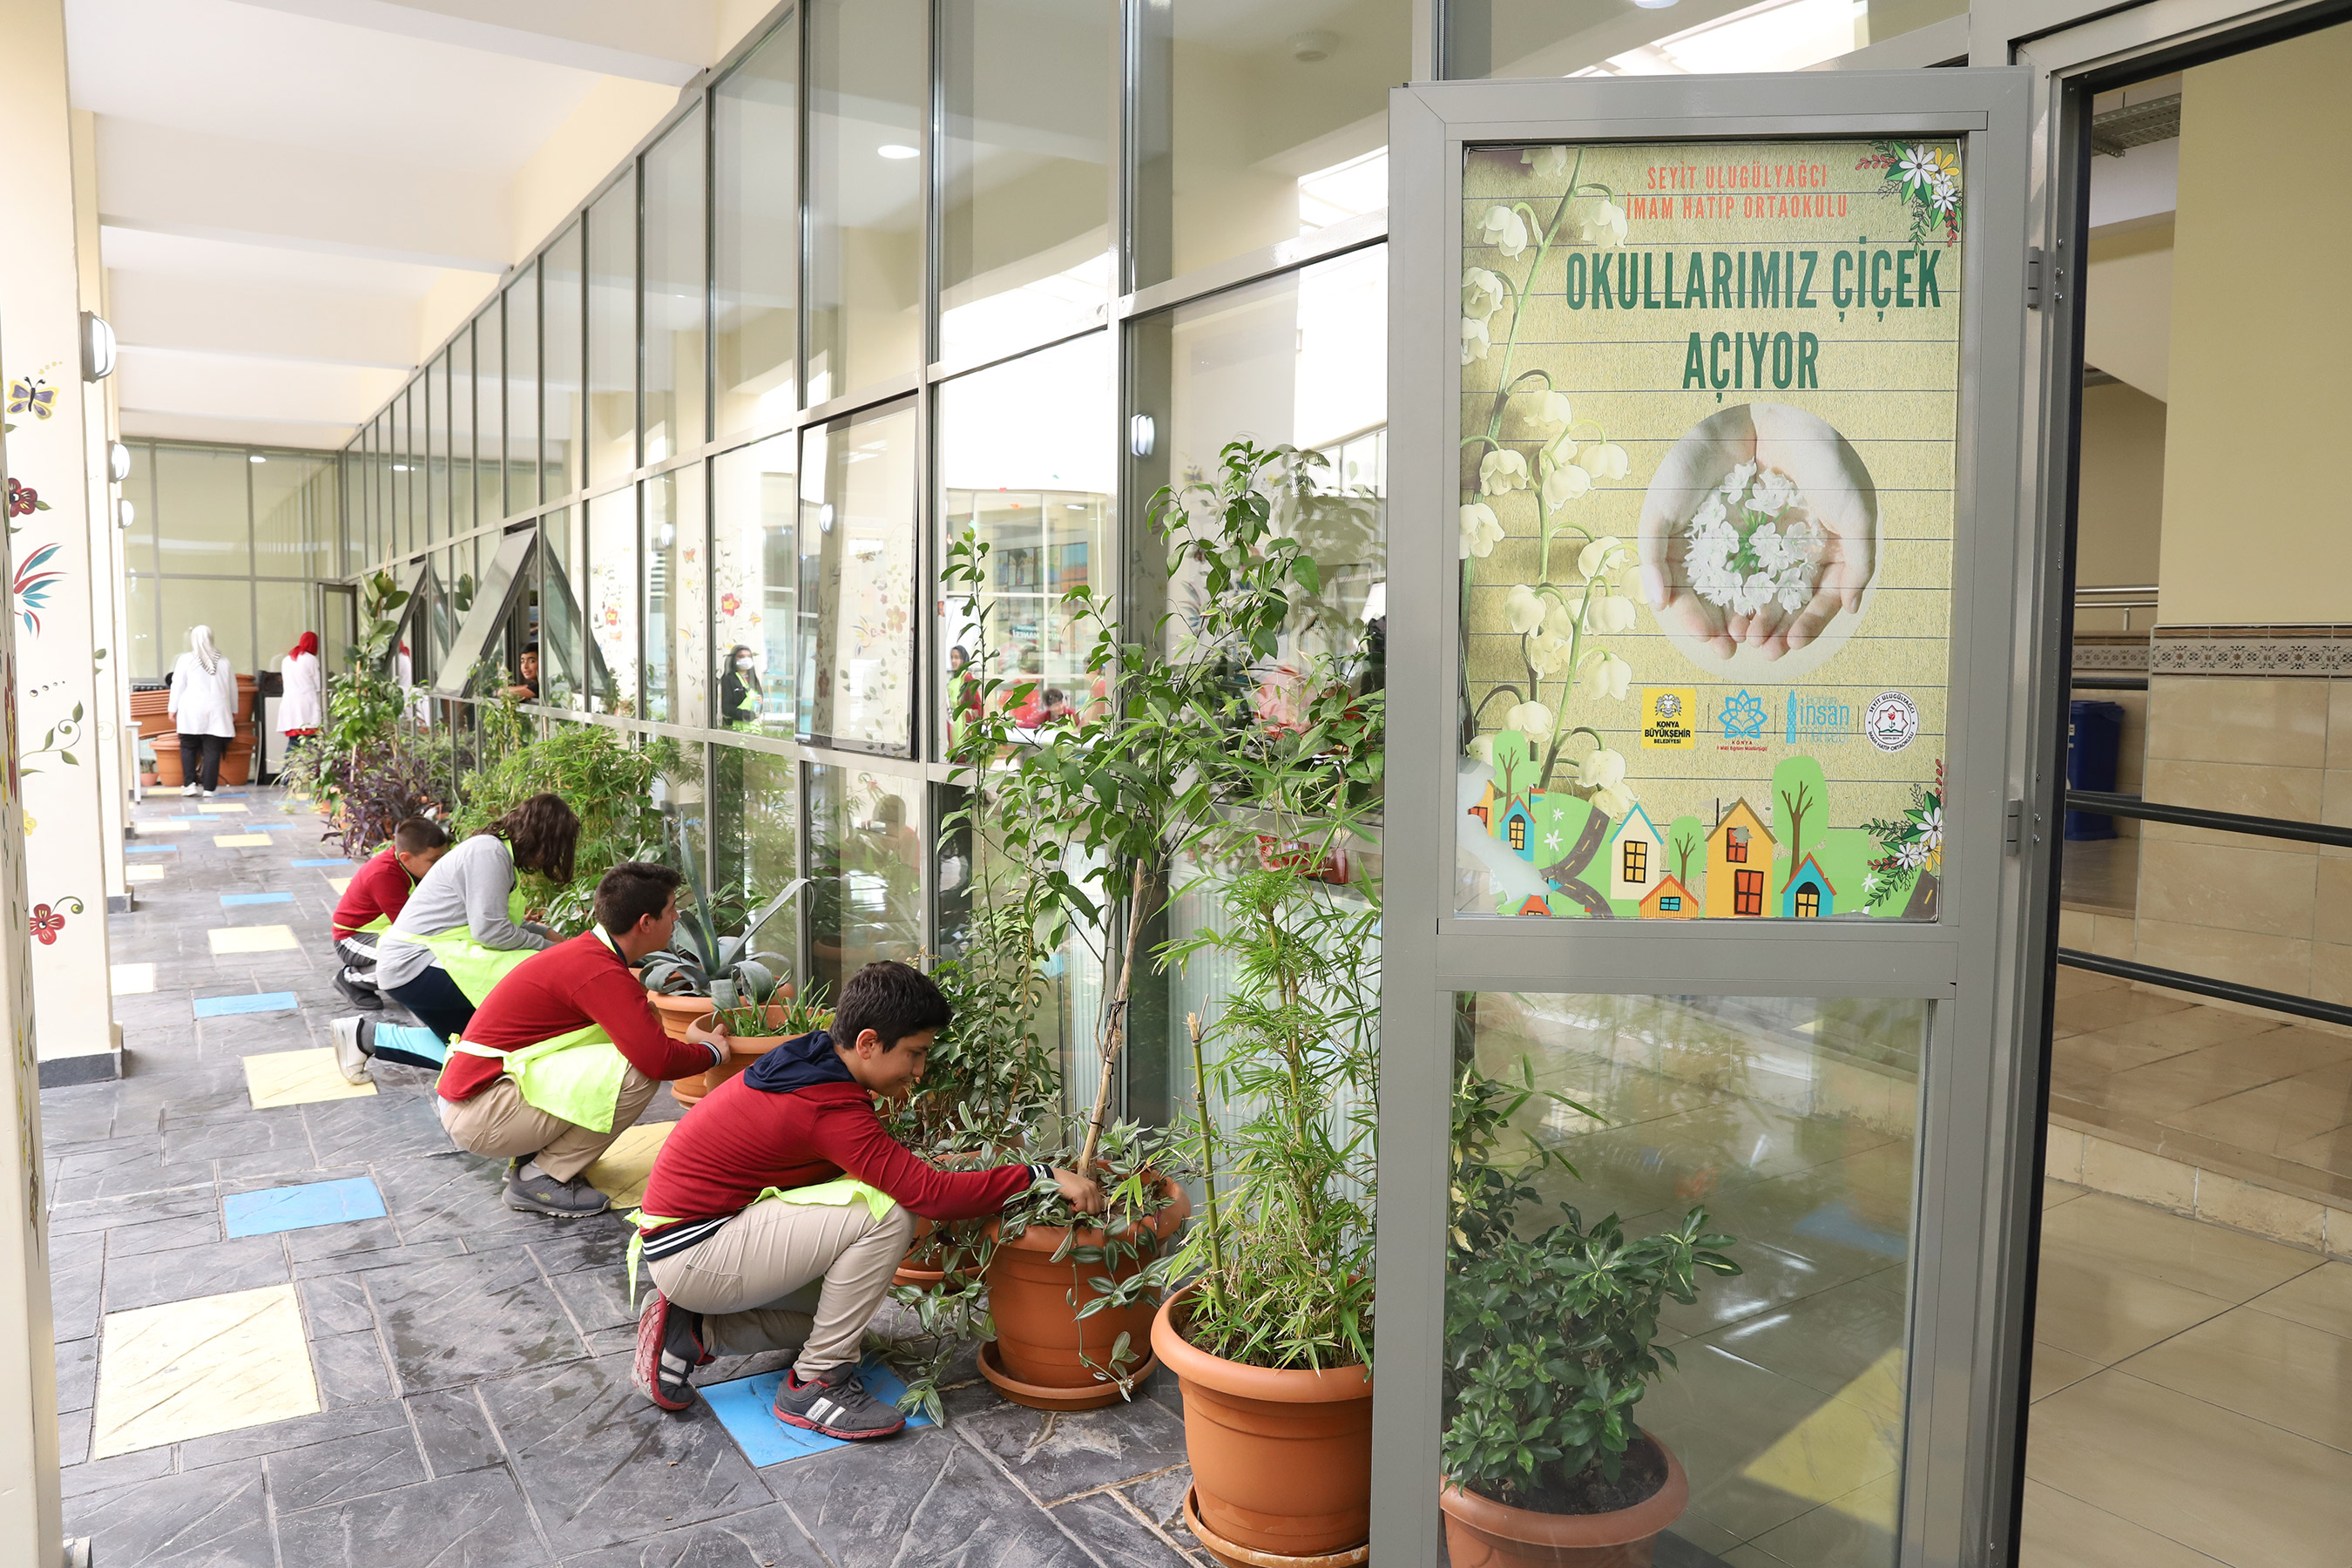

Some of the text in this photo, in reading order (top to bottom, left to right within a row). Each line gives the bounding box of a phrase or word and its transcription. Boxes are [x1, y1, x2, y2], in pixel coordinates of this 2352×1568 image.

[1647, 159, 1827, 189] SEYİT ULUGÜLYAĞCI
[1626, 191, 1847, 220] İMAM HATİP ORTAOKULU
[1567, 235, 1942, 322] OKULLARIMIZ ÇİÇEK
[1682, 331, 1819, 402] AÇIYOR
[1801, 699, 1849, 726] insan
[1645, 727, 1691, 739] BÜYÜKŞEHİR
